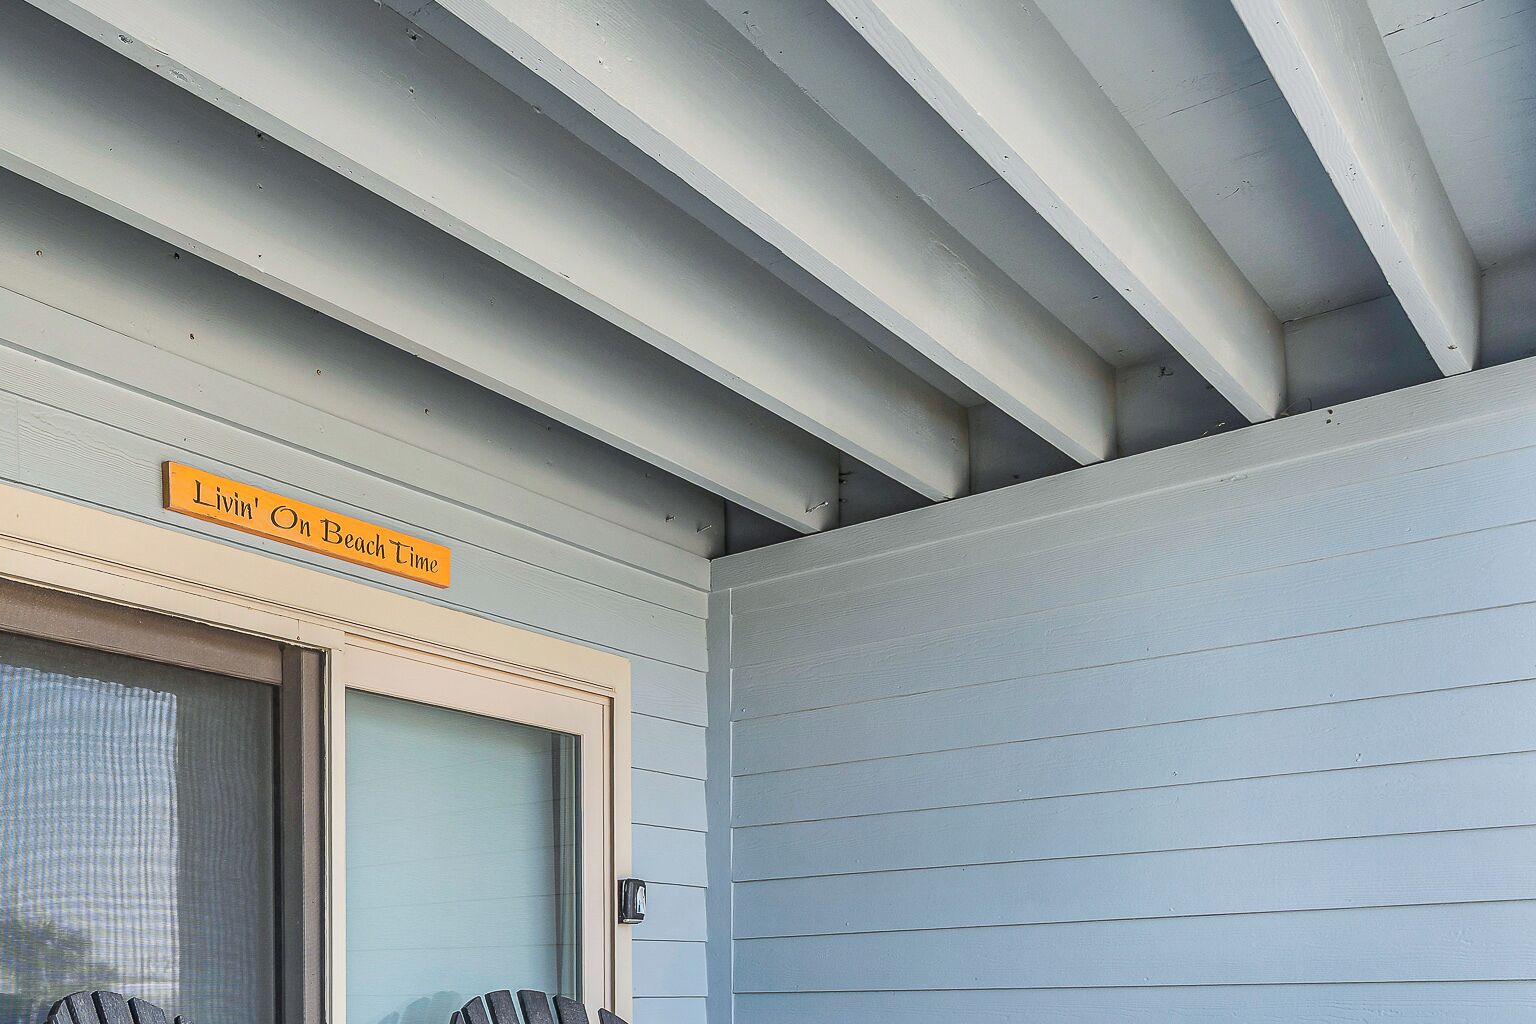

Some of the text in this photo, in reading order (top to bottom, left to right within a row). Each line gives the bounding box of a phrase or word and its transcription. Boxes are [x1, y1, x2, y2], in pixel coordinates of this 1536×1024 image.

[192, 479, 439, 574] Livin' On Beach Time
